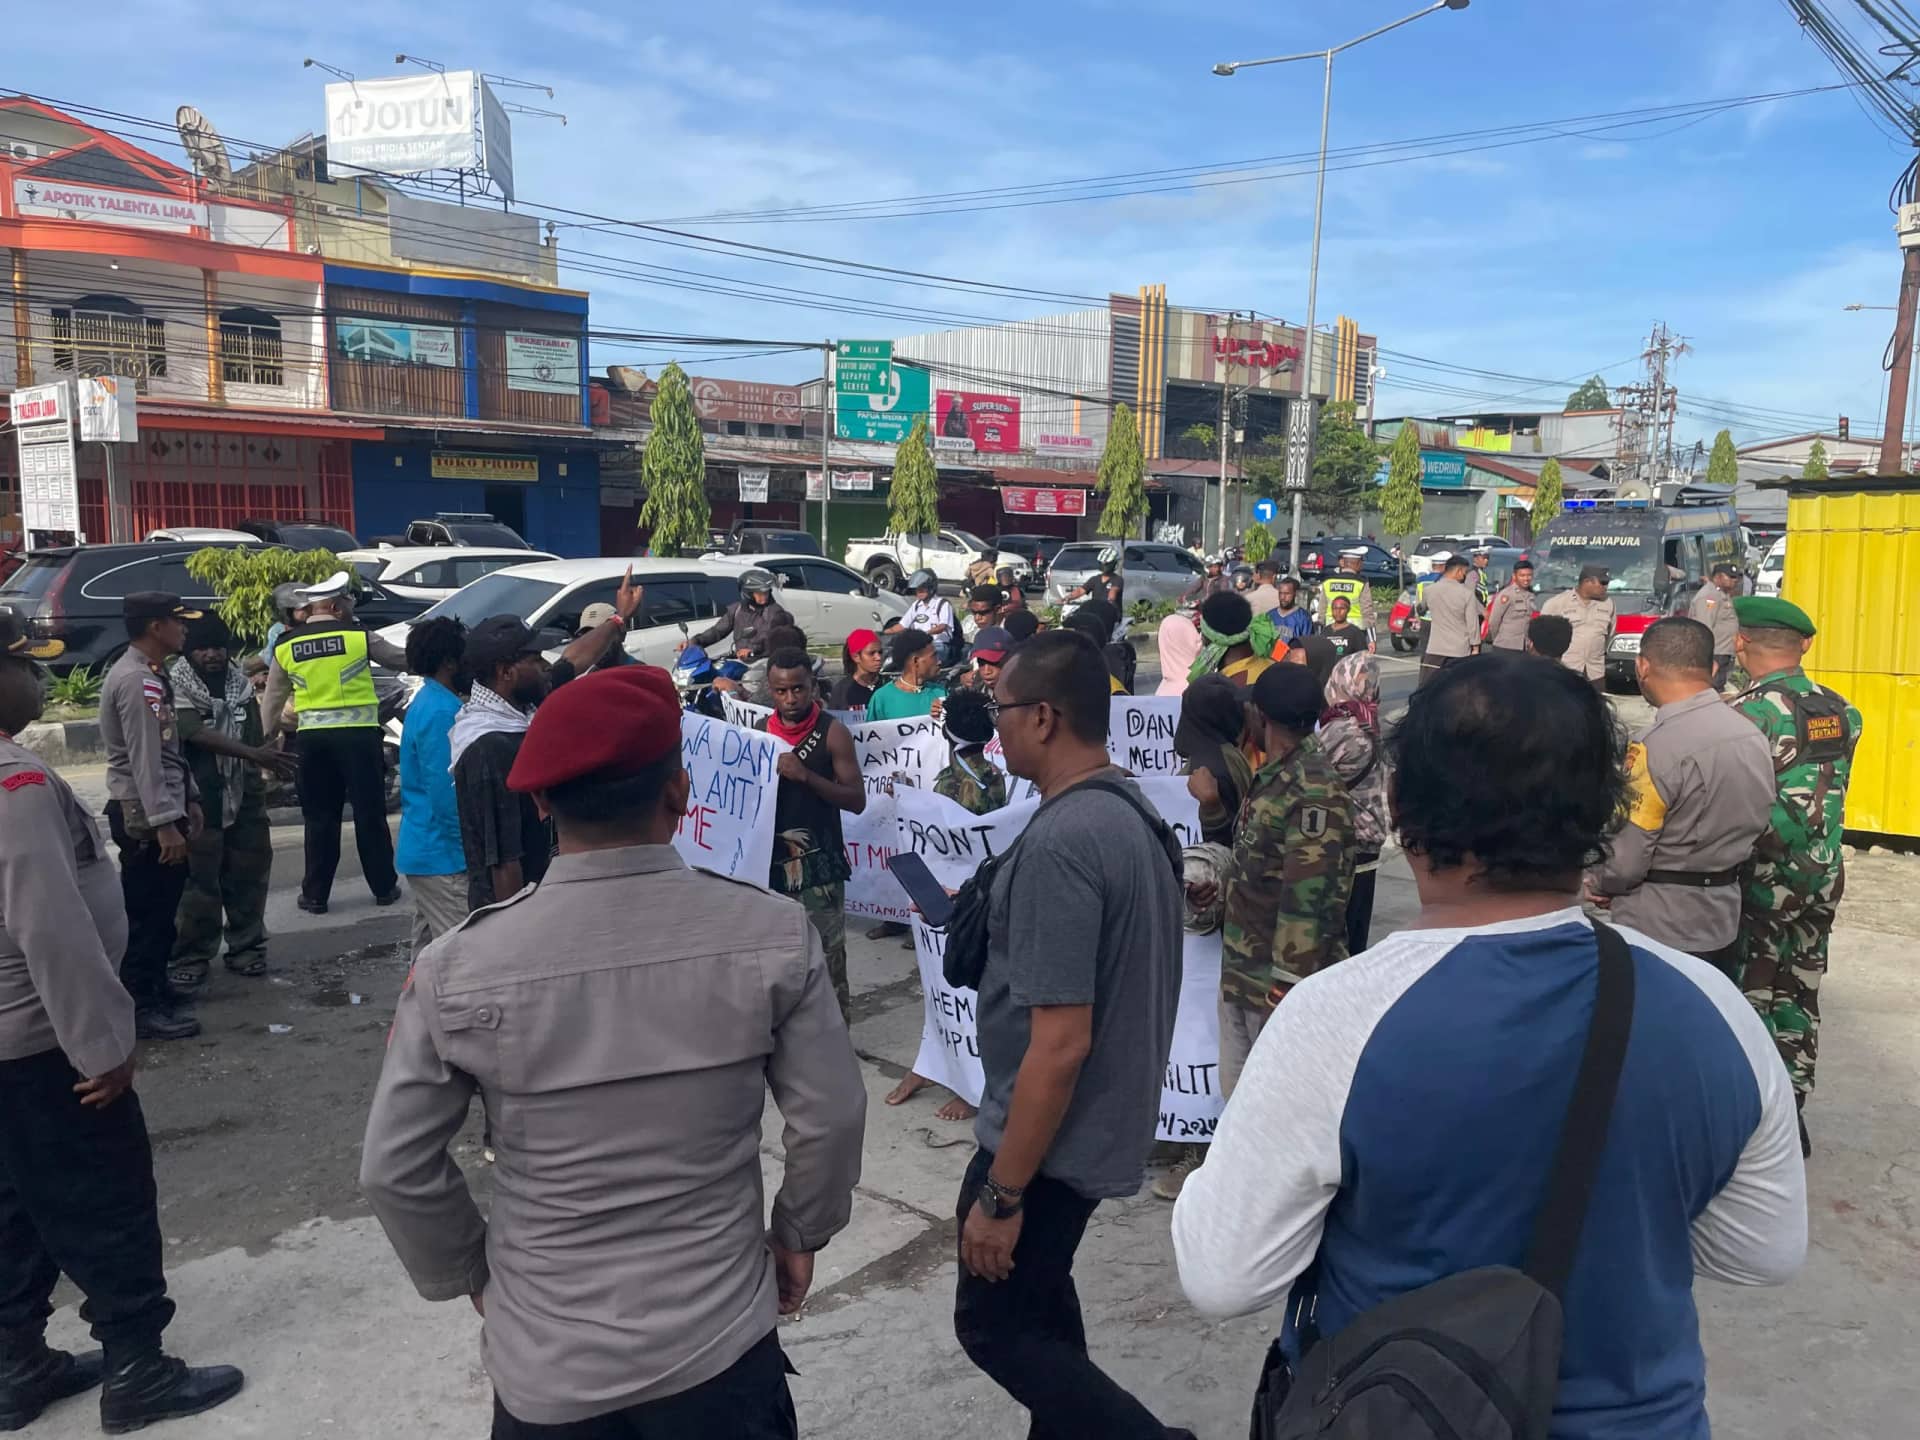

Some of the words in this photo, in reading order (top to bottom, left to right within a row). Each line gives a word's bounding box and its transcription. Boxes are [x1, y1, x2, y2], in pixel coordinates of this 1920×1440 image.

[363, 96, 463, 132] JOTUN
[42, 190, 96, 208] APOTIK
[99, 197, 159, 216] TALENTA
[163, 205, 196, 221] LIMA
[18, 402, 40, 419] TALENTA
[42, 399, 57, 416] LIMA
[437, 458, 477, 467] TOKO
[482, 459, 535, 470] PRIDIA
[1427, 461, 1462, 474] WEDRINK
[1550, 536, 1587, 546] POLRES
[1590, 536, 1640, 547] JAYAPURA
[1331, 583, 1353, 592] POLISI
[293, 638, 342, 658] POLISI
[1127, 708, 1174, 740] DAN
[798, 730, 822, 760] DISE
[722, 729, 775, 783] DAN
[864, 747, 921, 768] ANTI
[705, 769, 763, 829] ANTI
